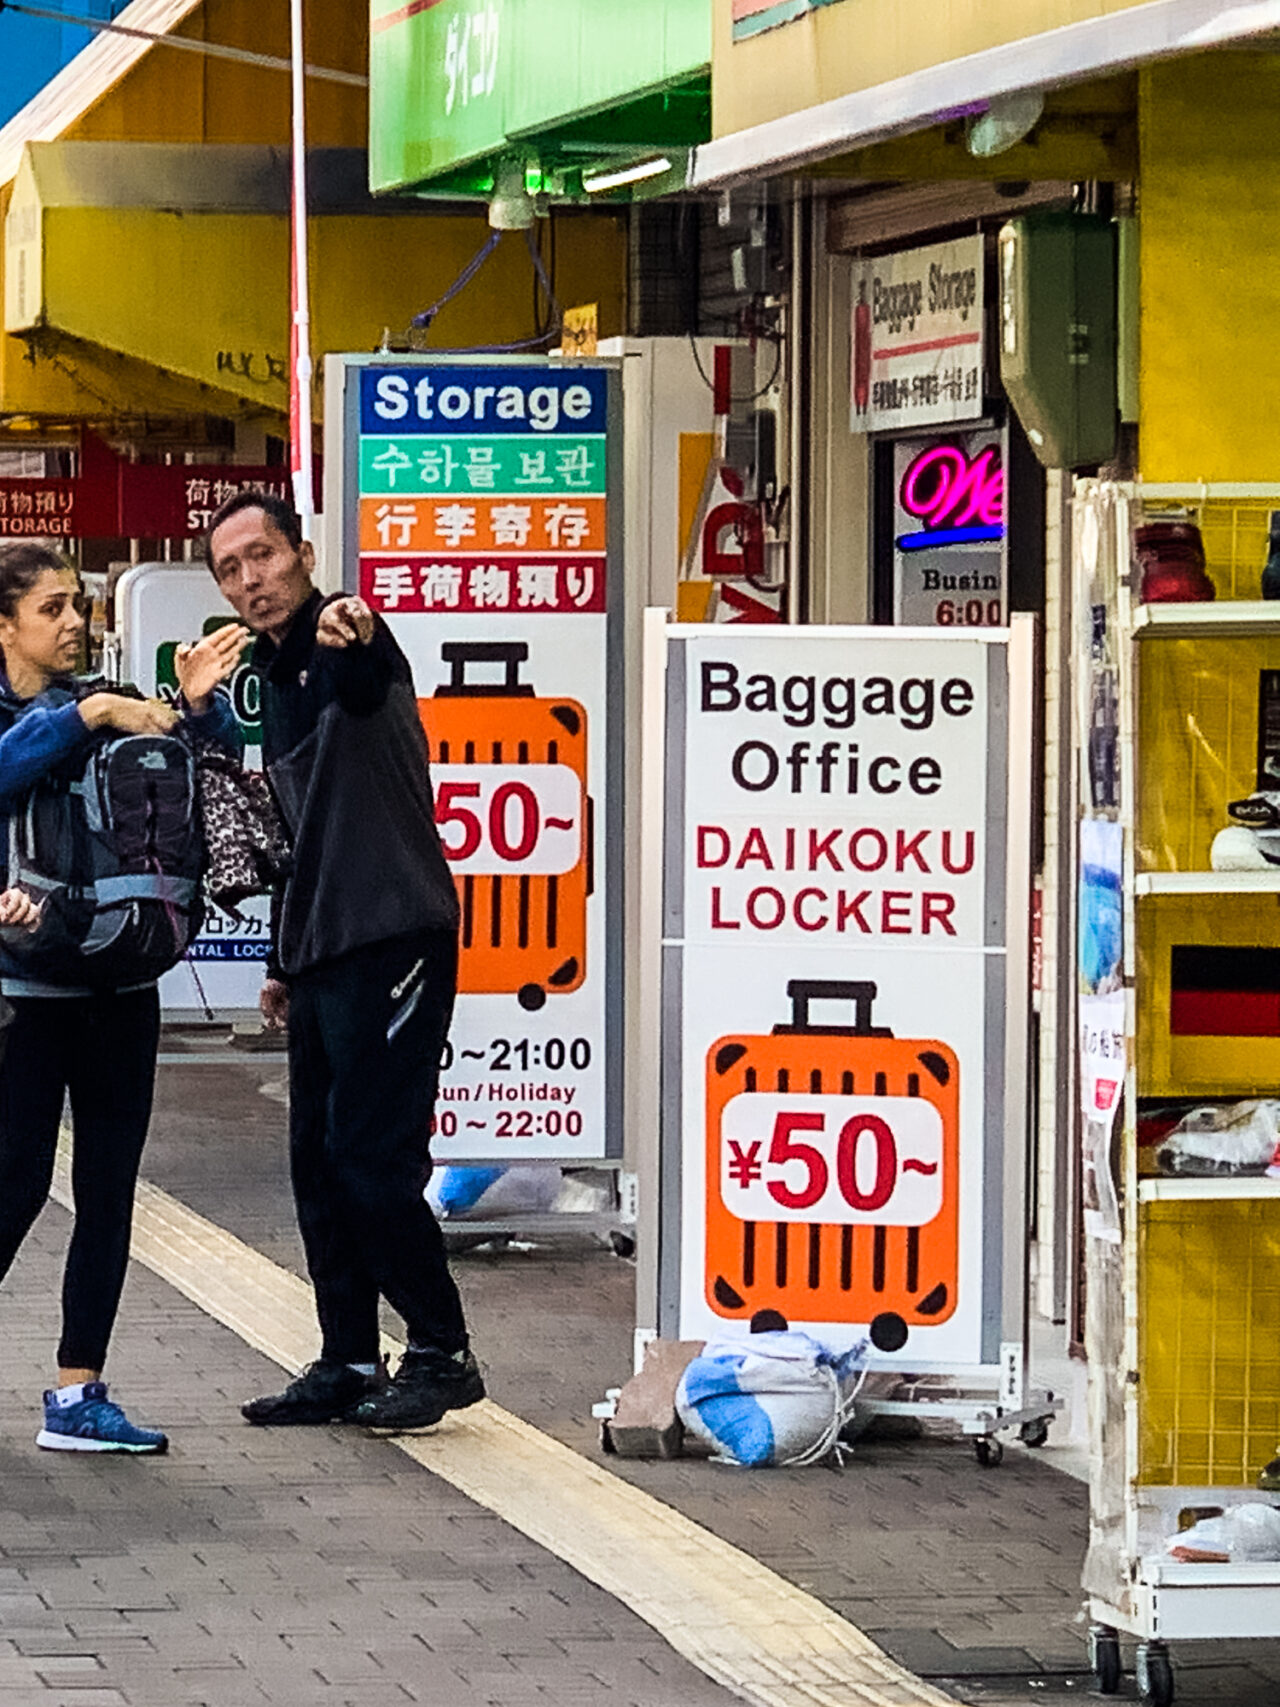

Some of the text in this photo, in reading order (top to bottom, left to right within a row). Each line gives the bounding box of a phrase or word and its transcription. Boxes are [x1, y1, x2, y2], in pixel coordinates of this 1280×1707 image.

[373, 374, 593, 431] Storage
[371, 443, 596, 489] 수하물 보관
[374, 503, 591, 548] 行李寄存
[372, 564, 595, 609] 手荷物預り
[922, 569, 998, 591] Busin
[700, 661, 975, 731] Baggage
[731, 740, 942, 796] Office
[696, 825, 975, 875] DAIKOKU
[710, 885, 957, 936] LOCKER
